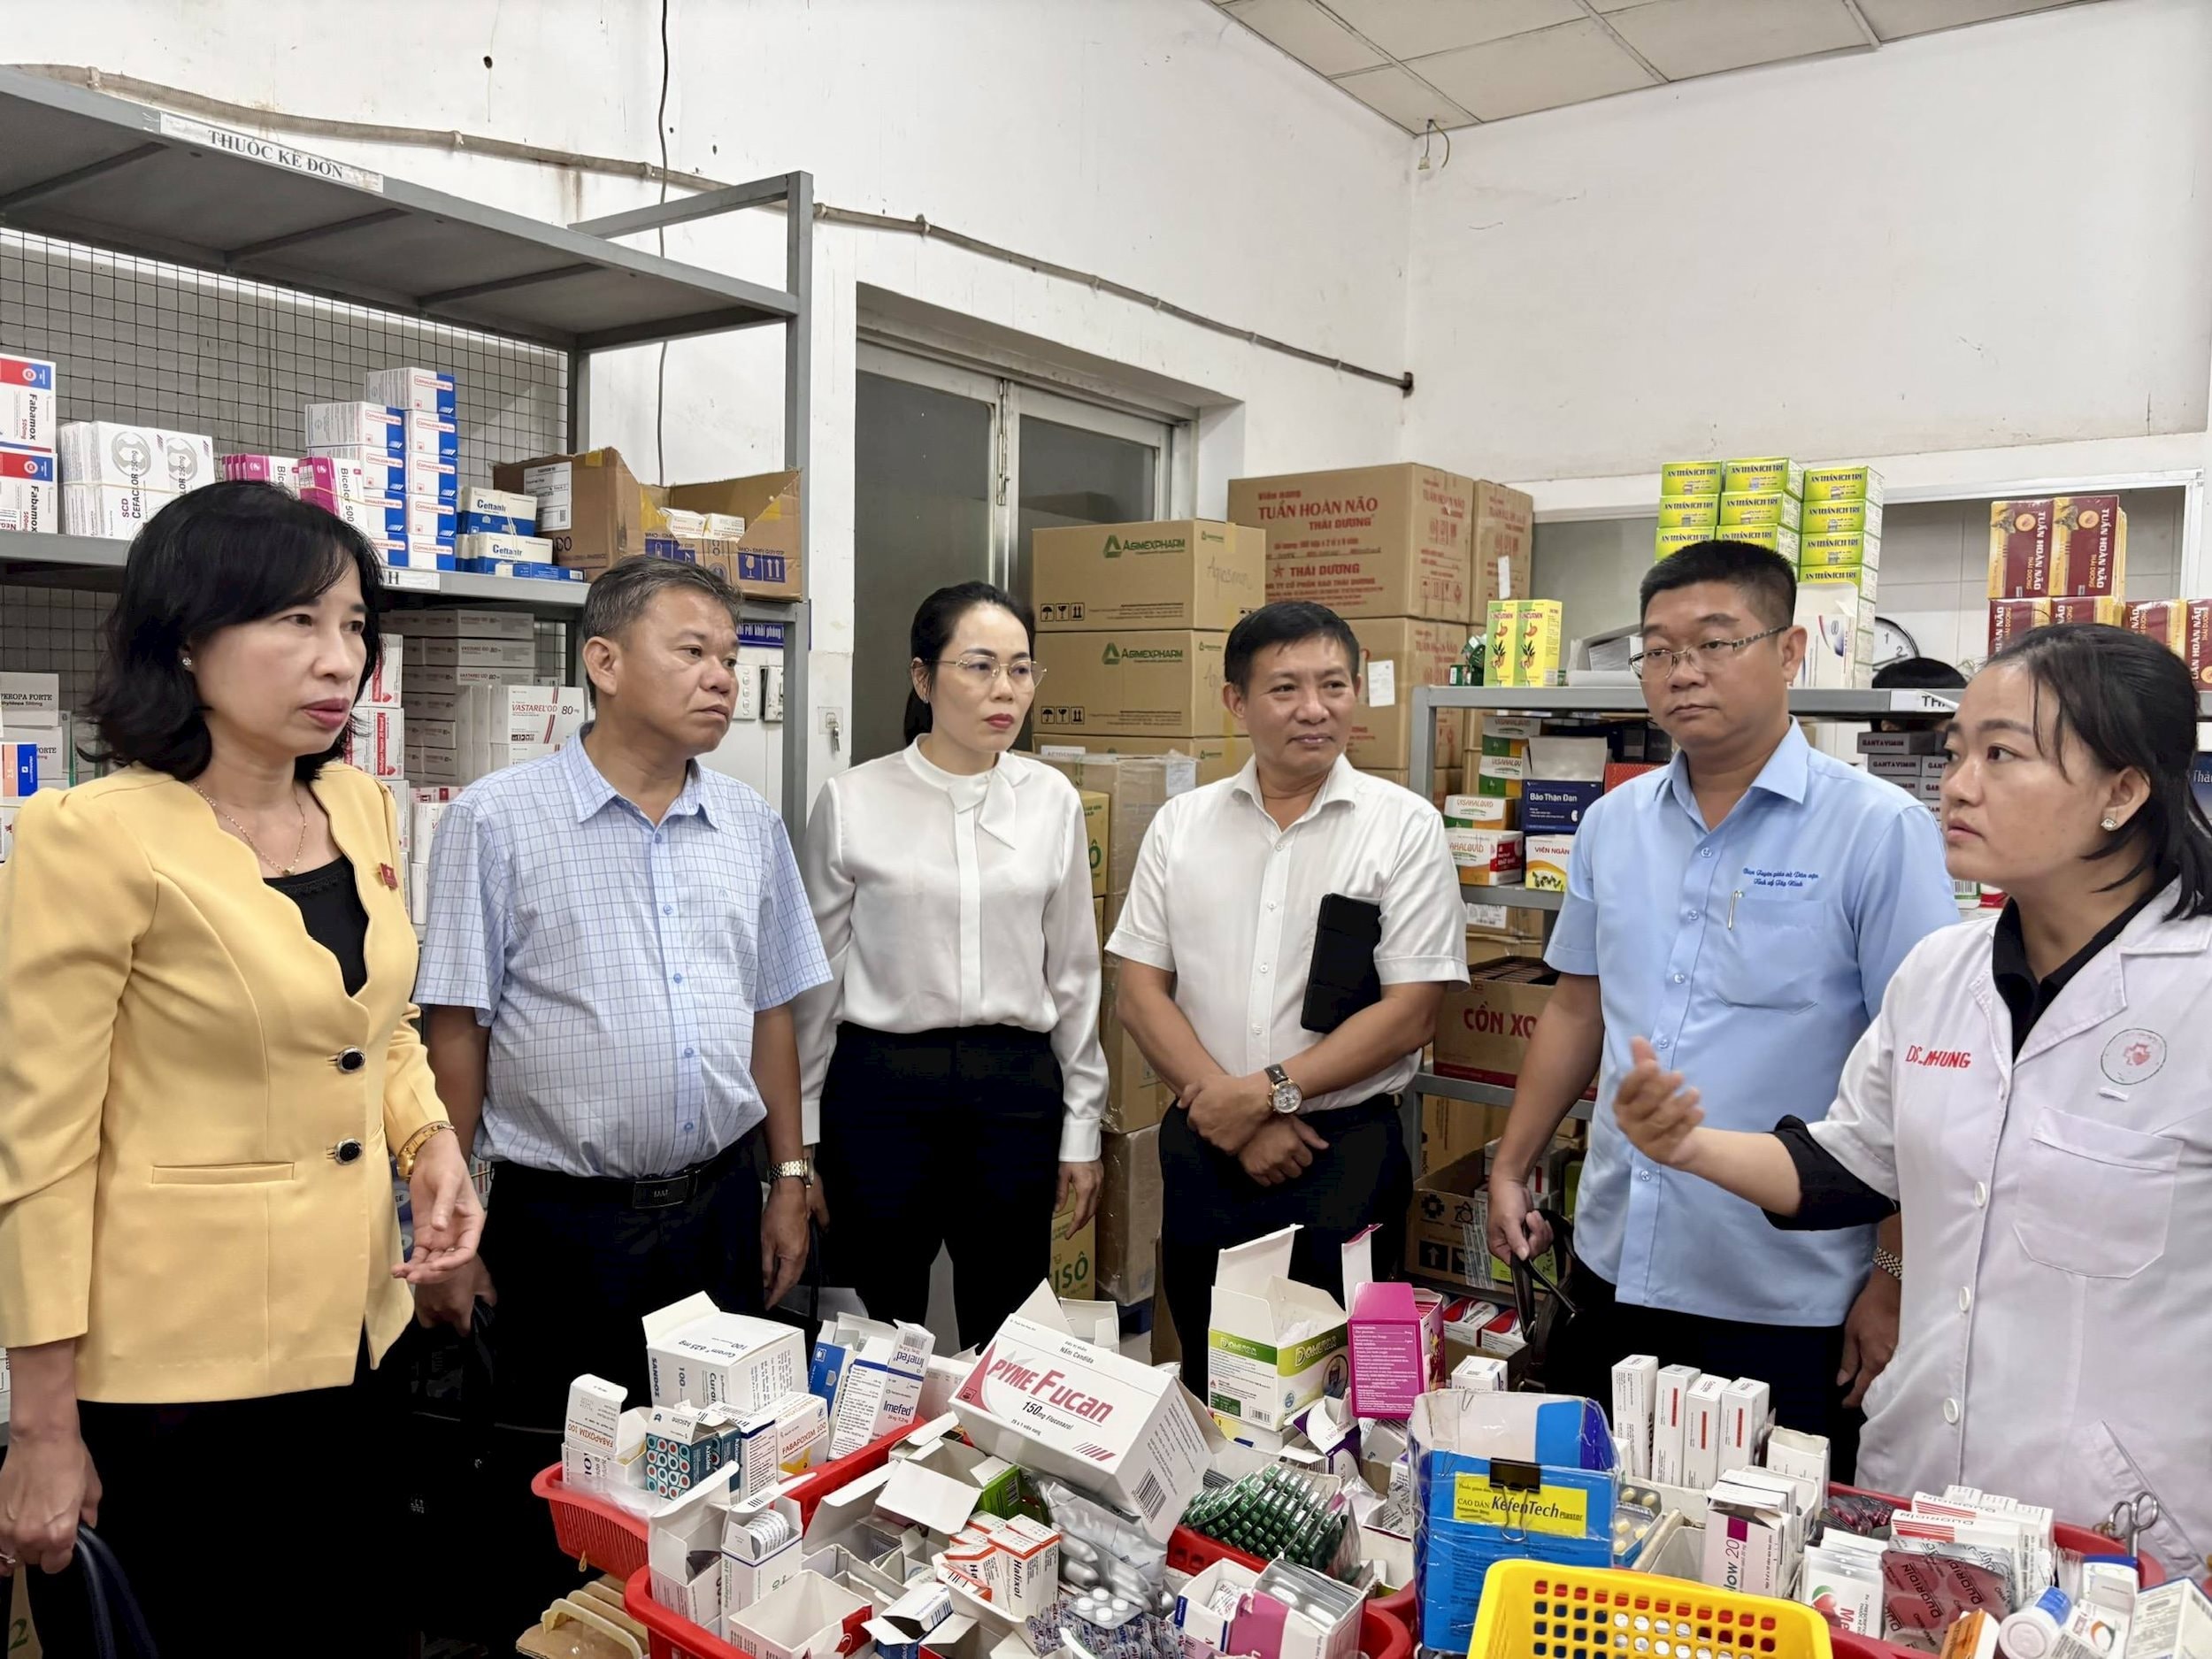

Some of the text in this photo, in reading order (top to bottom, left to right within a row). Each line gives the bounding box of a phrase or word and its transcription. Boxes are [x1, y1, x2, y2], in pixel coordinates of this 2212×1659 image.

[208, 130, 273, 159] THUỐC
[307, 157, 342, 179] ĐƠN
[121, 498, 130, 518] SCD
[1345, 496, 1378, 513] NÃO
[1290, 565, 1315, 578] THÁI
[2033, 570, 2043, 590] NÃO
[2097, 568, 2107, 588] NÃO
[1885, 632, 1889, 644] 1
[1896, 646, 1903, 657] 2
[1463, 1001, 1537, 1040] CỒN XO
[896, 1351, 925, 1367] Imefed
[1072, 1351, 1094, 1363] Candida
[1031, 1369, 1114, 1424] Fucan
[883, 1400, 911, 1417] Imefed
[1492, 1496, 1559, 1518] KefenTech
[1726, 1540, 1740, 1558] 20
